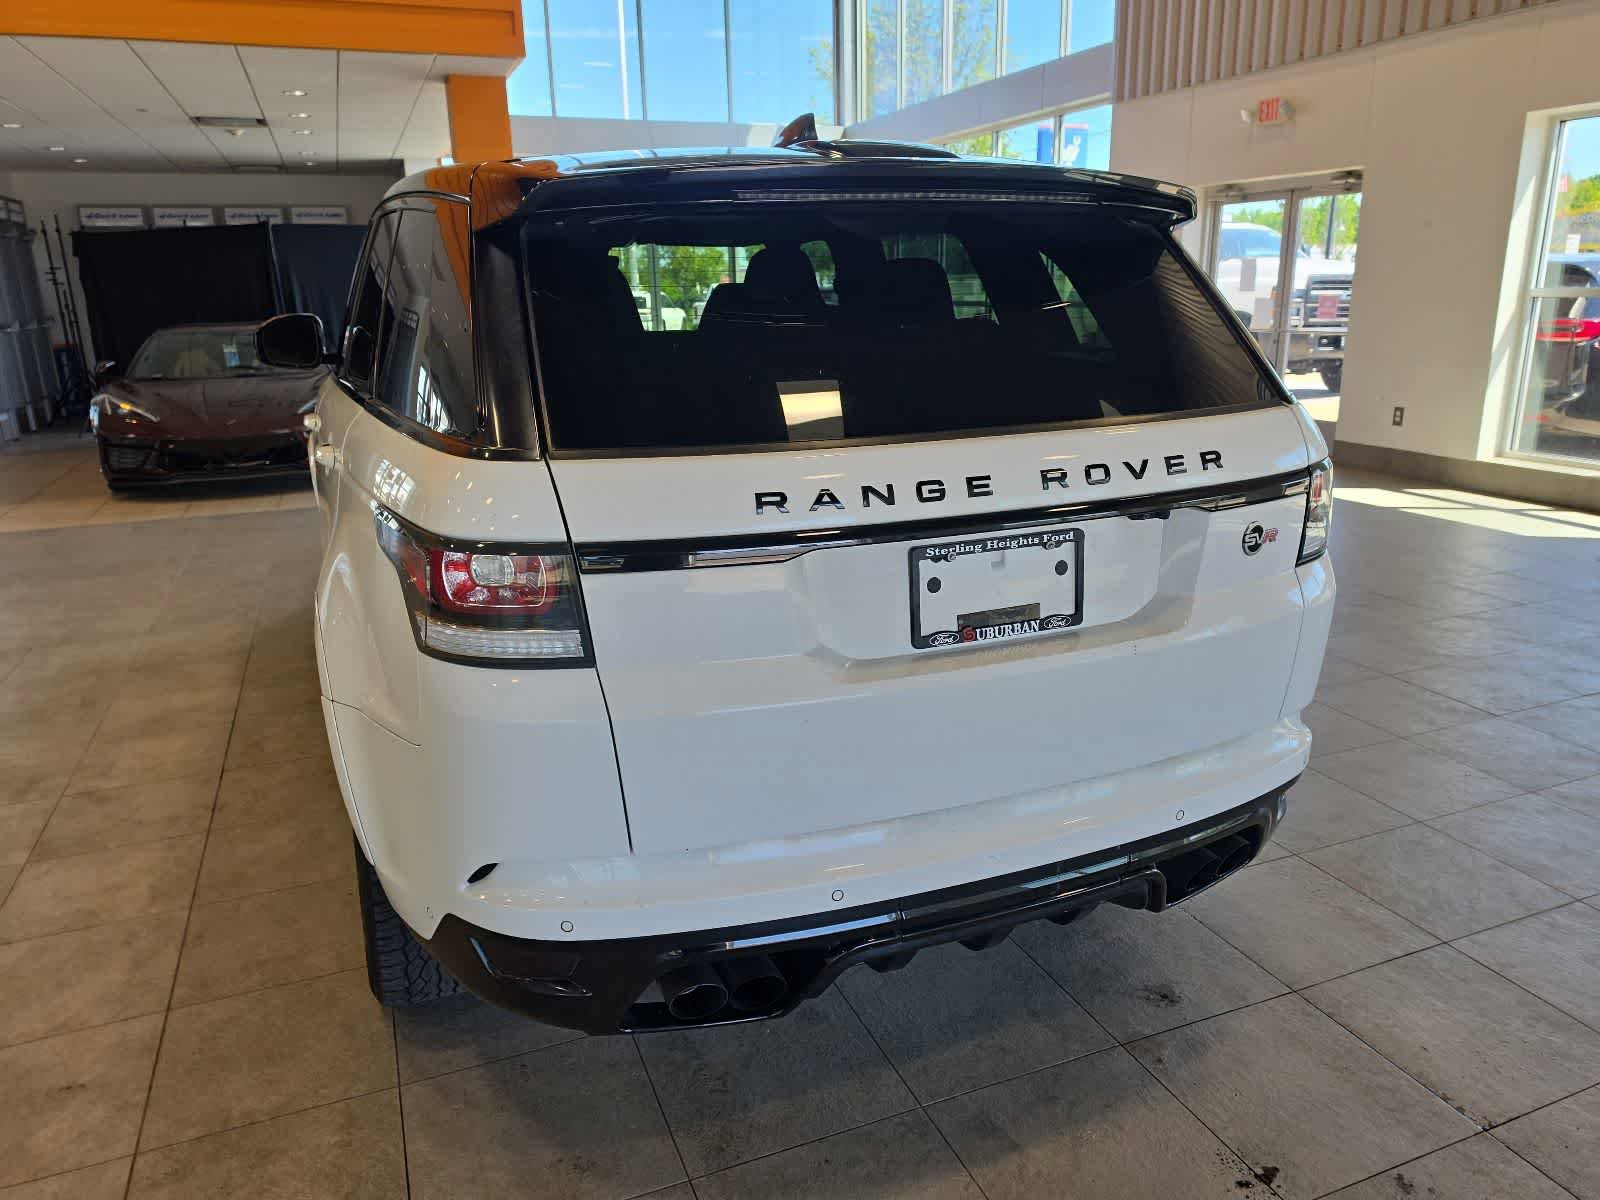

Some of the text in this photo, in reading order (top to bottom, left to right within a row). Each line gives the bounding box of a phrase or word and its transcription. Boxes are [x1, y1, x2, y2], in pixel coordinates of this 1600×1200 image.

[1258, 96, 1281, 122] EXIT
[754, 450, 1225, 515] RANGE ROVER
[926, 531, 1074, 558] Sterling Heights Ford
[932, 616, 1070, 646] Ford SUBURBAN Ford
